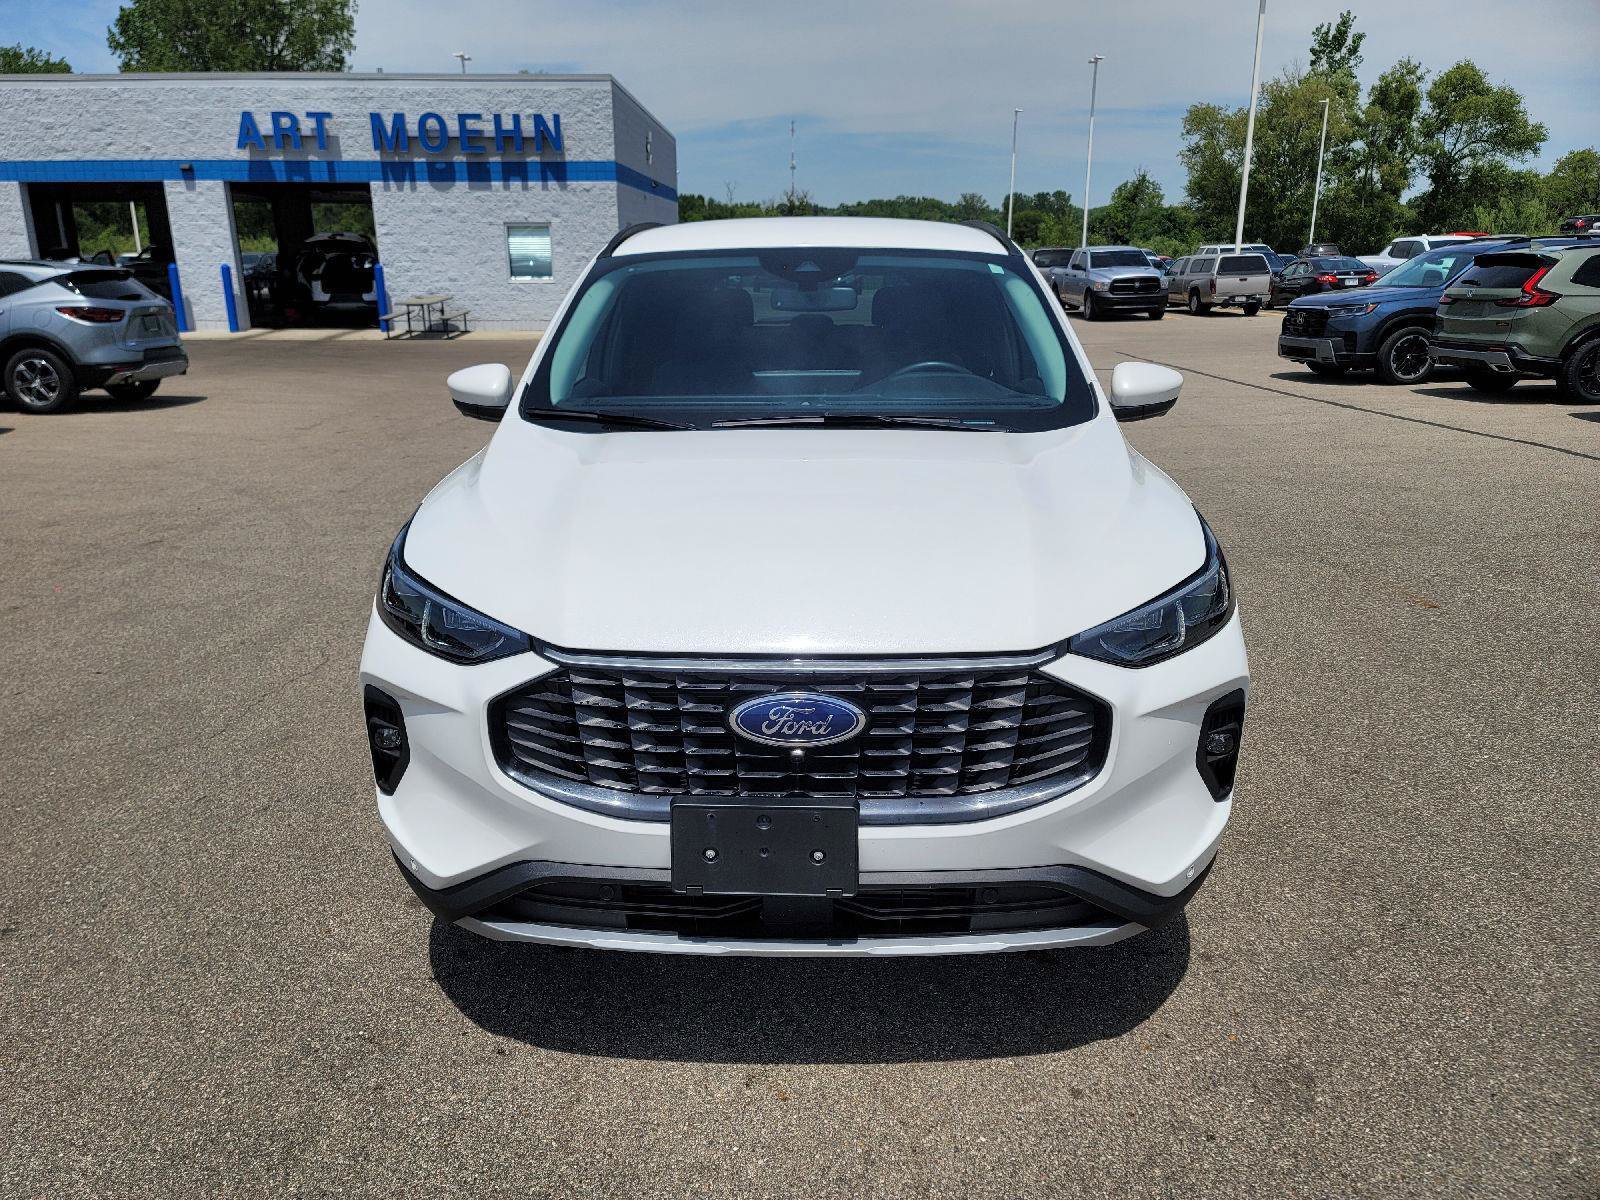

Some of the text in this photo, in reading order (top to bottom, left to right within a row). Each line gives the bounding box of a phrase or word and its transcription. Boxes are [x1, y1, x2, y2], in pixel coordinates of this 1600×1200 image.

[238, 111, 562, 153] ART MOEHN
[761, 706, 832, 735] Ford
